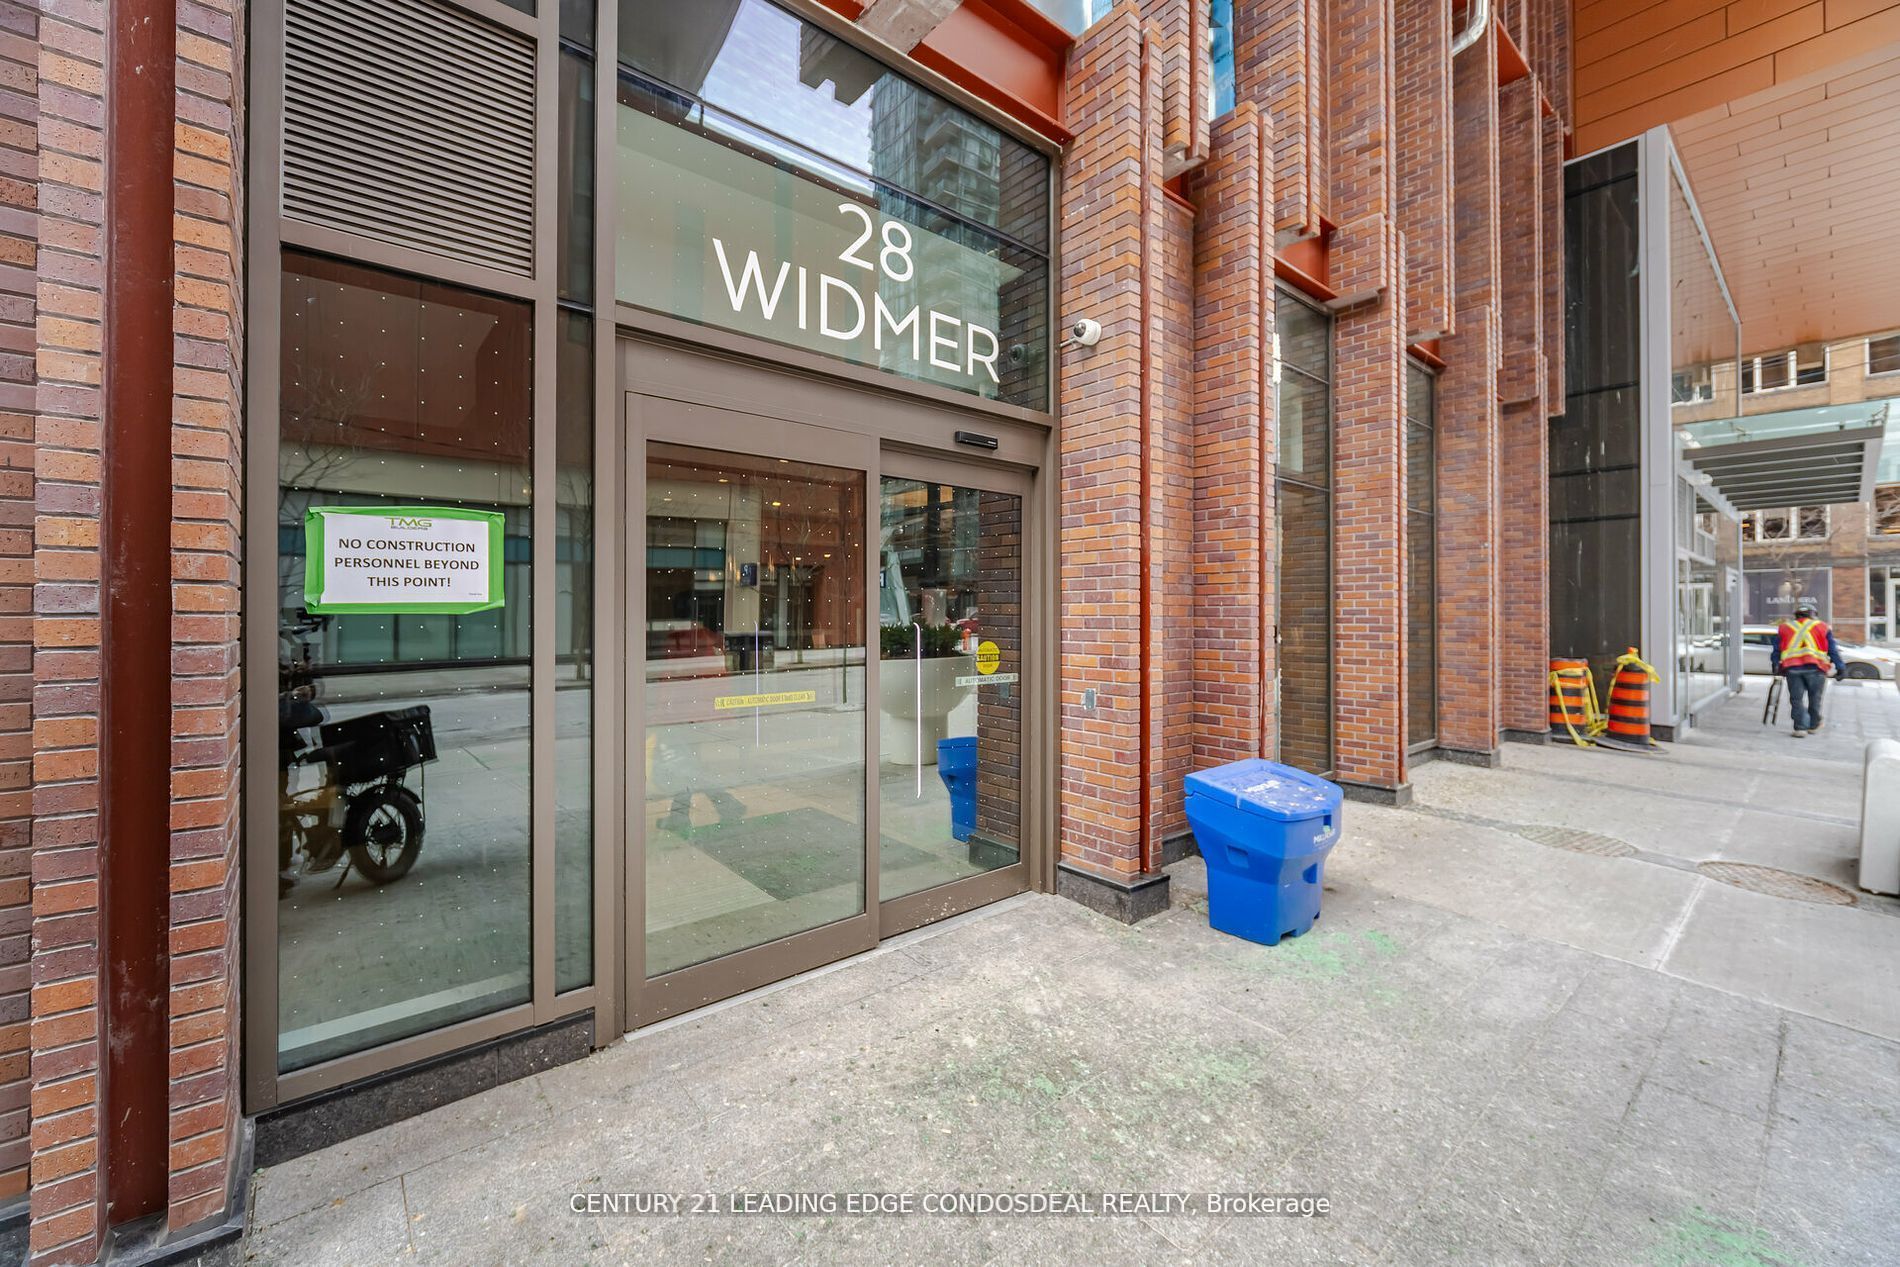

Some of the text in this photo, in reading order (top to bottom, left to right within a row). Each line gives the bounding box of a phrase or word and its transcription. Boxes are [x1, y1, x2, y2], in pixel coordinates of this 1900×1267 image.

[838, 203, 914, 282] 28
[712, 237, 1000, 384] WIDMER
[384, 517, 432, 528] TMG
[338, 538, 475, 553] NO CONSTRUCTION
[334, 557, 479, 570] PERSONNEL BEYOND
[367, 576, 451, 588] THIS POINT!
[965, 676, 993, 684] AUTOMATIC
